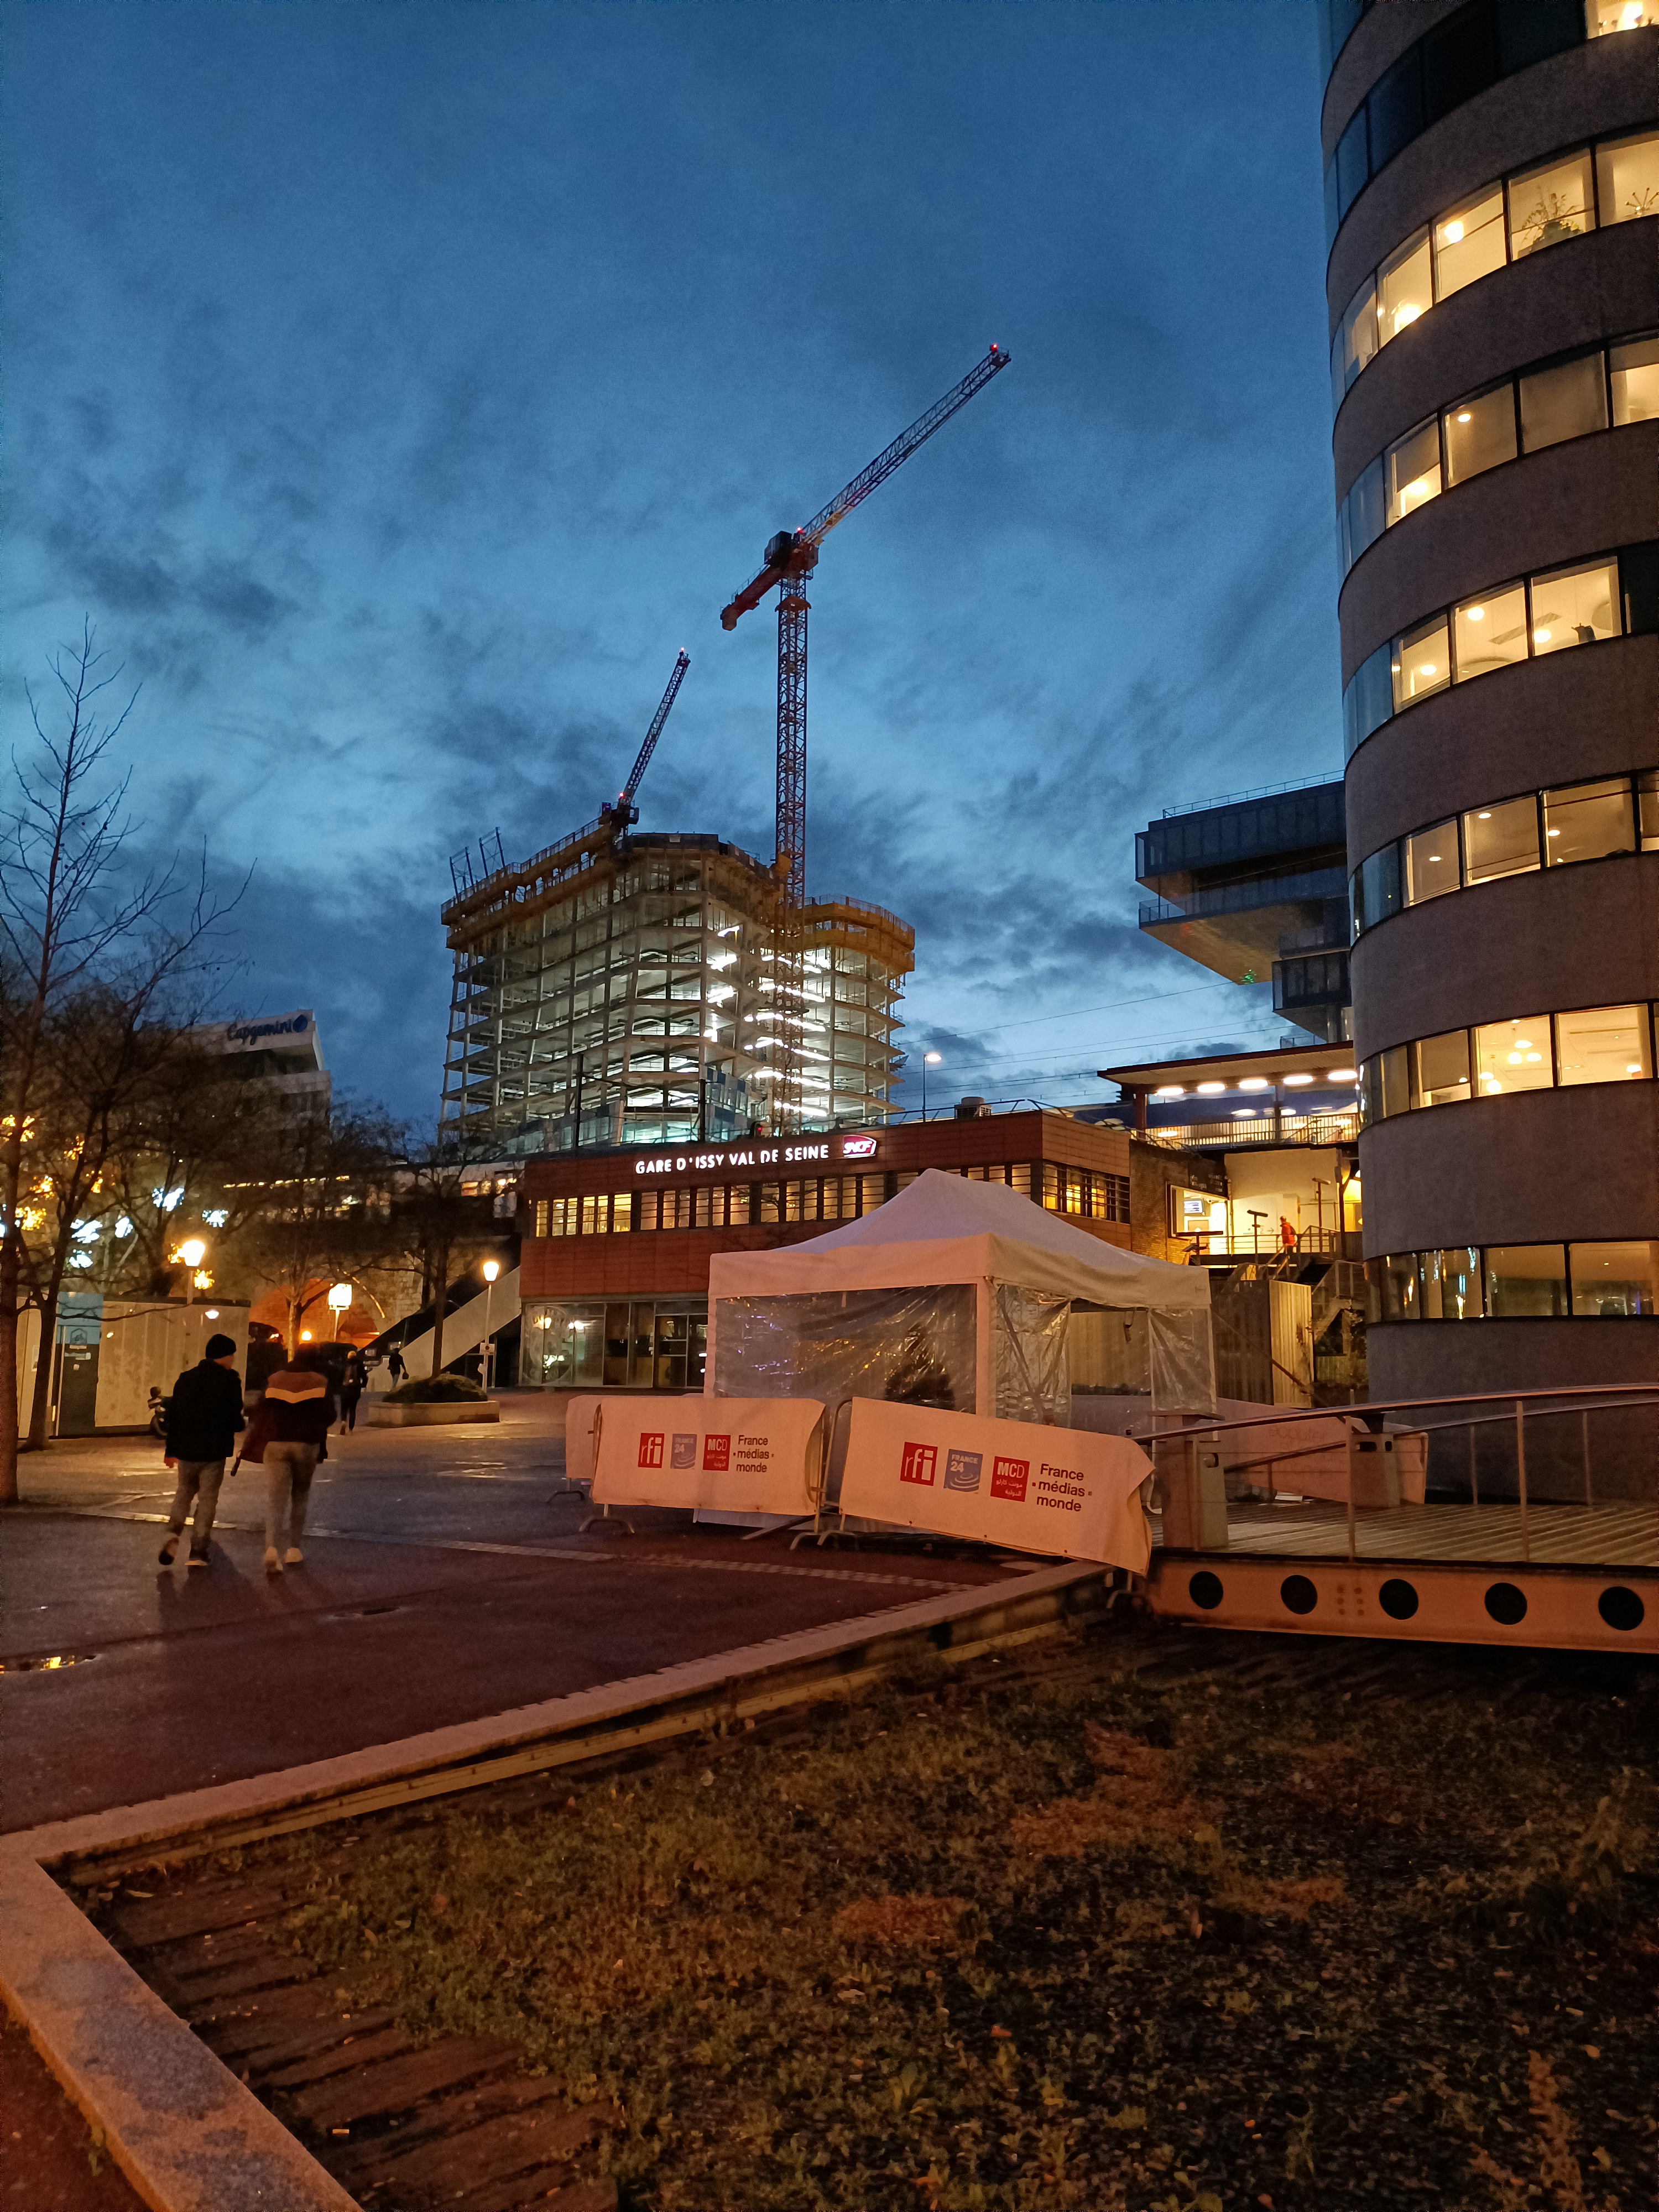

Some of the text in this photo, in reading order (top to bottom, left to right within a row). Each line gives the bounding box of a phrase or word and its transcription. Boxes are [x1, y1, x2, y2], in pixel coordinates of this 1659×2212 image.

[635, 1159, 672, 1175] GARE
[729, 1151, 756, 1166] VAL
[760, 1149, 778, 1164] DE
[785, 1145, 829, 1161] SEINE
[707, 1438, 728, 1452] MCD
[738, 1434, 768, 1446] France
[640, 1437, 662, 1464] rfi
[674, 1444, 685, 1453] 24
[737, 1448, 769, 1459] médias
[904, 1448, 933, 1481] rfi
[951, 1454, 978, 1464] FRANCE
[736, 1462, 767, 1473] monde
[950, 1461, 964, 1473] 24
[997, 1462, 1025, 1478] MCD
[1040, 1463, 1084, 1481] France
[1038, 1480, 1085, 1497] médias
[1036, 1496, 1082, 1512] monde
